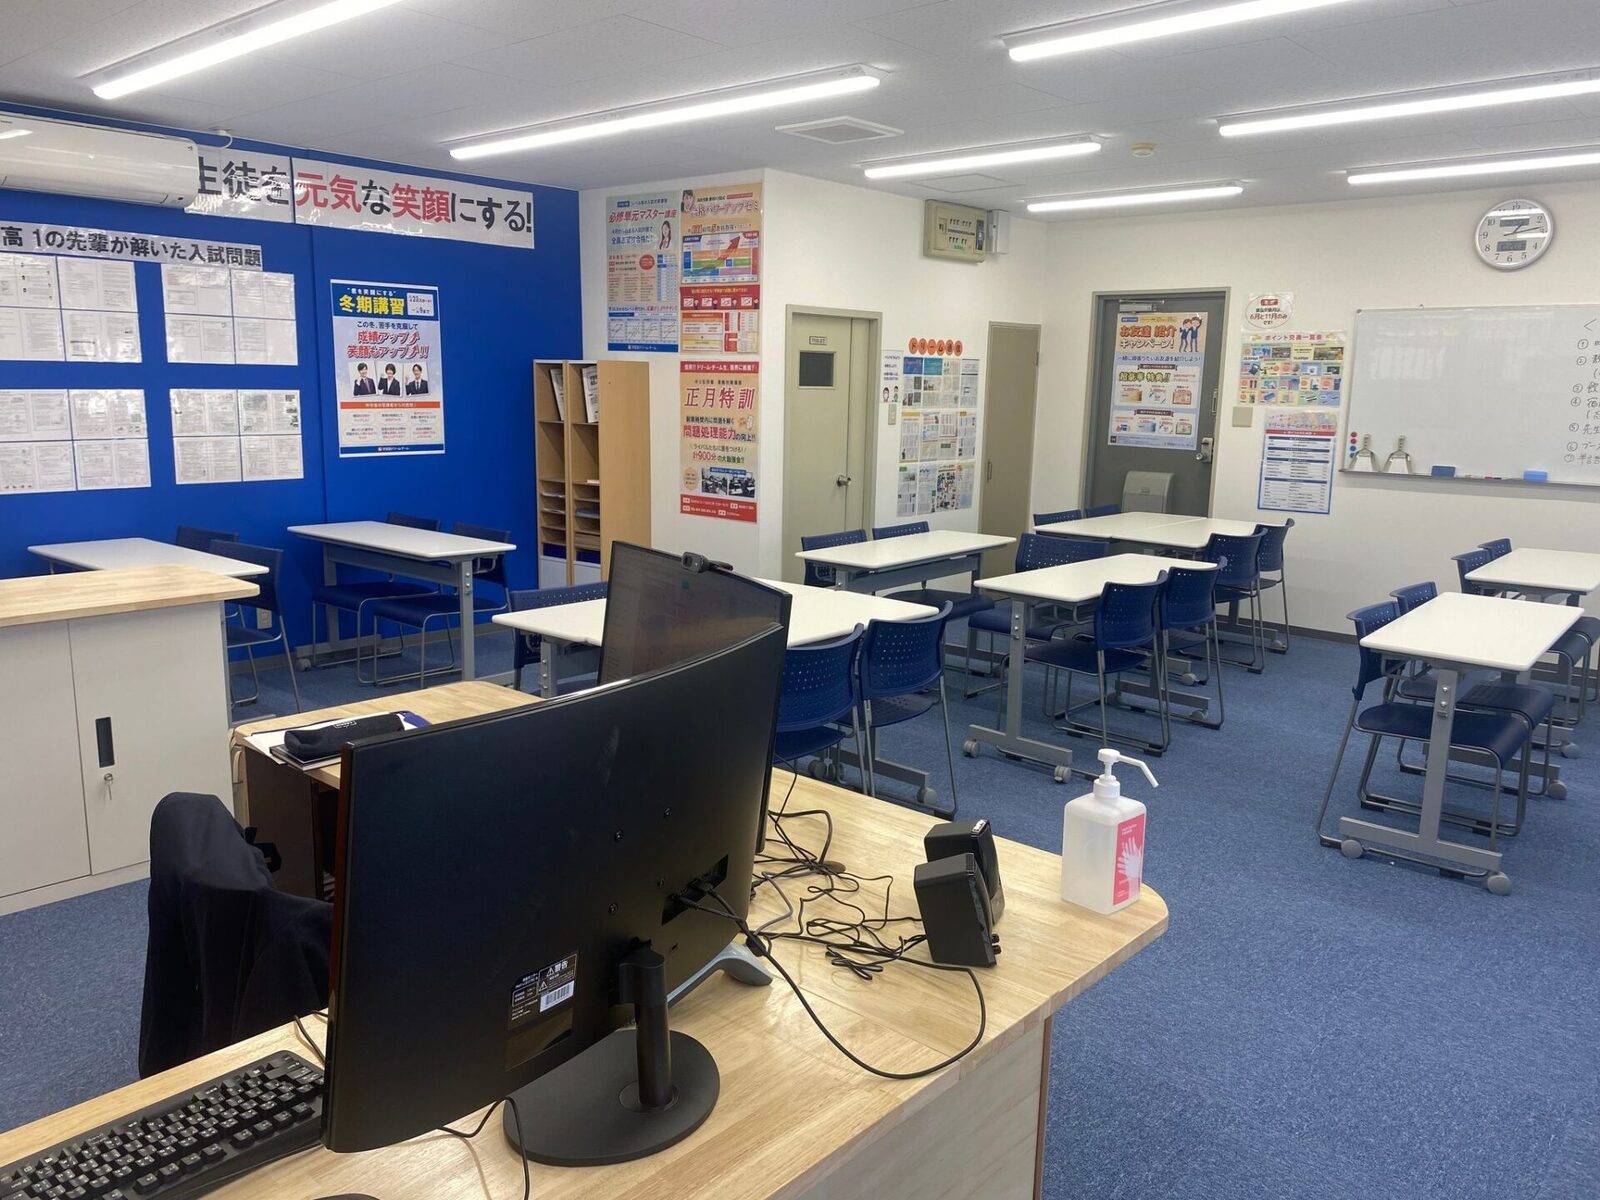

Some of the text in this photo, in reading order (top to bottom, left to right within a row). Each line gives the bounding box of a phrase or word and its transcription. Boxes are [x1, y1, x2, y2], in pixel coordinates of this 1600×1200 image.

[340, 294, 405, 315] 冬期講習
[684, 387, 756, 410] 正月特訓
